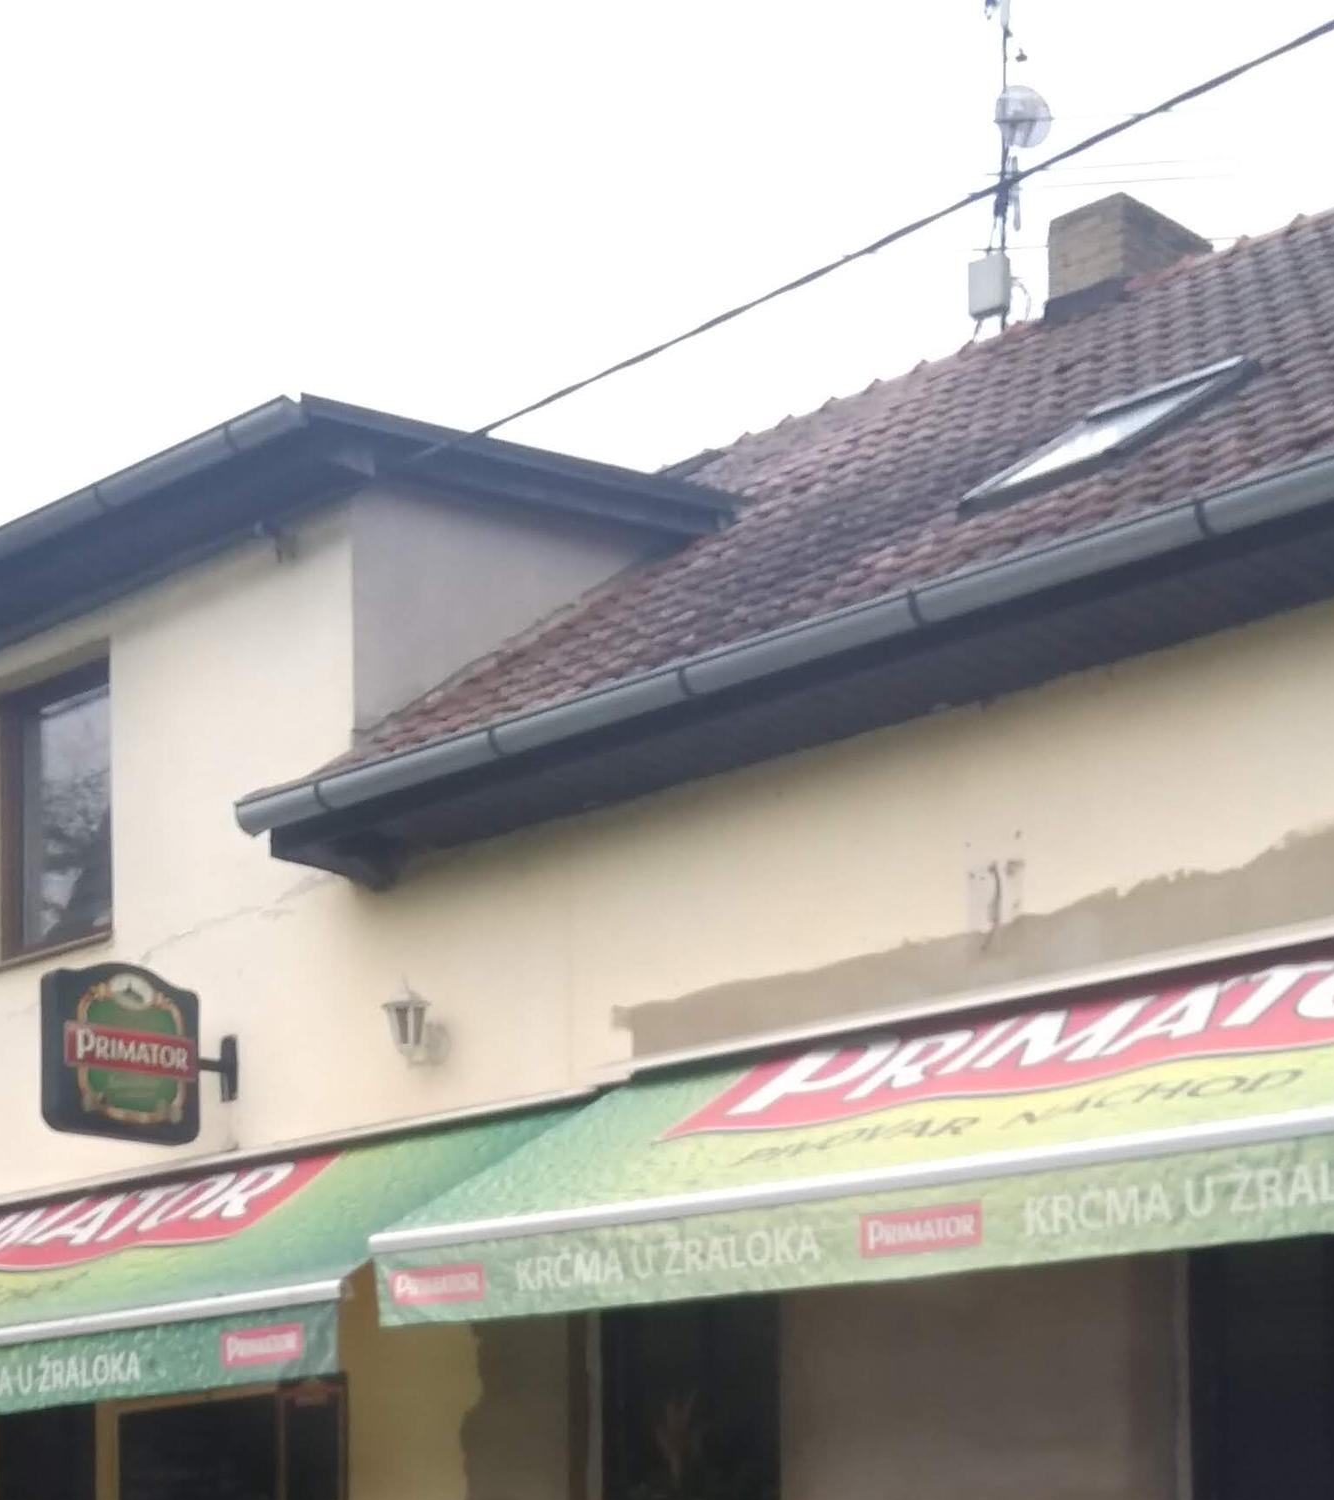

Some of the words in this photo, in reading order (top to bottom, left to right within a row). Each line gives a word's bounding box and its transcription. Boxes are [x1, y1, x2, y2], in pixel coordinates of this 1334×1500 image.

[75, 1027, 190, 1072] PRIMATOR
[1022, 1182, 1173, 1237] KRČMA
[1183, 1176, 1214, 1219] U
[867, 1213, 978, 1251] PRIMATOR
[516, 1246, 625, 1292] KRČMA
[631, 1239, 654, 1280] U
[663, 1222, 823, 1276] ŽRALOKA
[17, 1364, 34, 1395] U
[37, 1350, 142, 1394] ŽRALOKA
